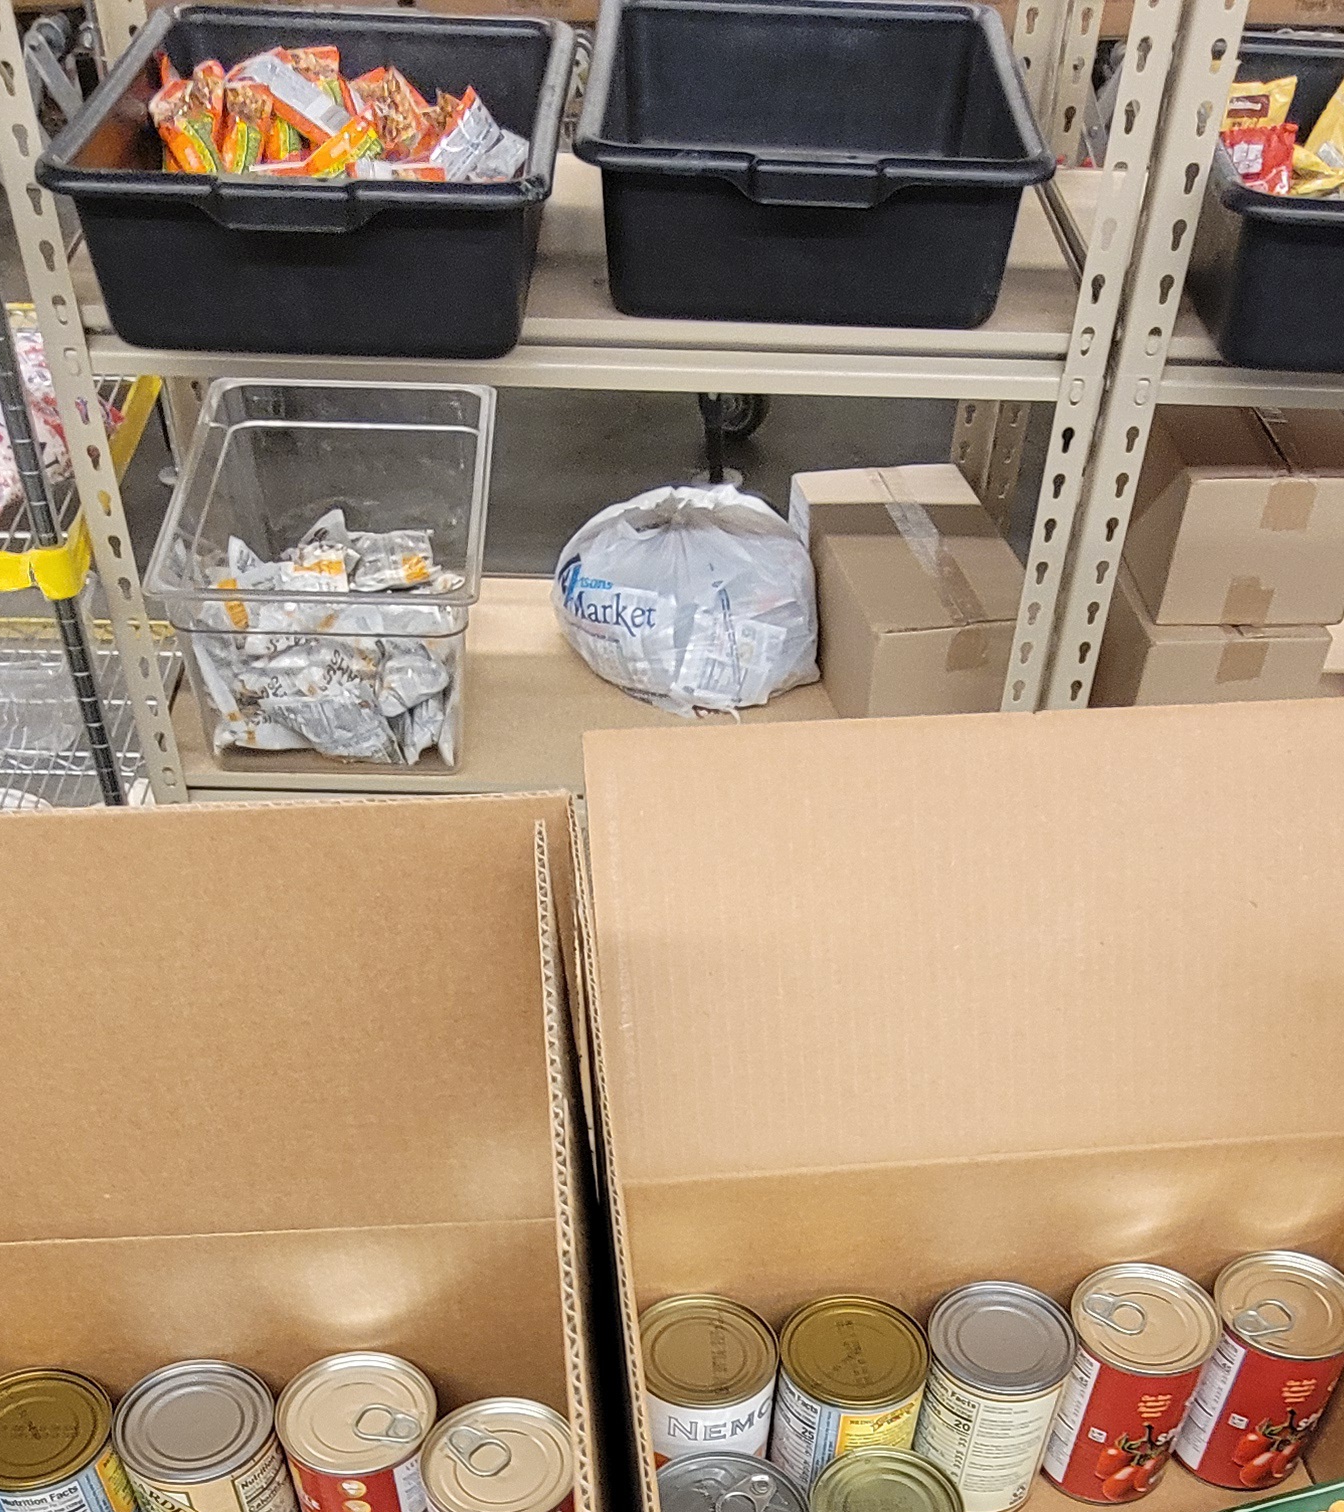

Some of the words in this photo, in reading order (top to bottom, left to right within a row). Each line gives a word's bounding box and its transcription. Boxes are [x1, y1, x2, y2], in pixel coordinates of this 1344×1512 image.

[801, 1428, 814, 1440] 25
[954, 1419, 971, 1432] 20
[240, 1455, 277, 1490] Nutrition
[1, 1494, 48, 1506] Nutrition
[50, 1485, 78, 1501] Facts
